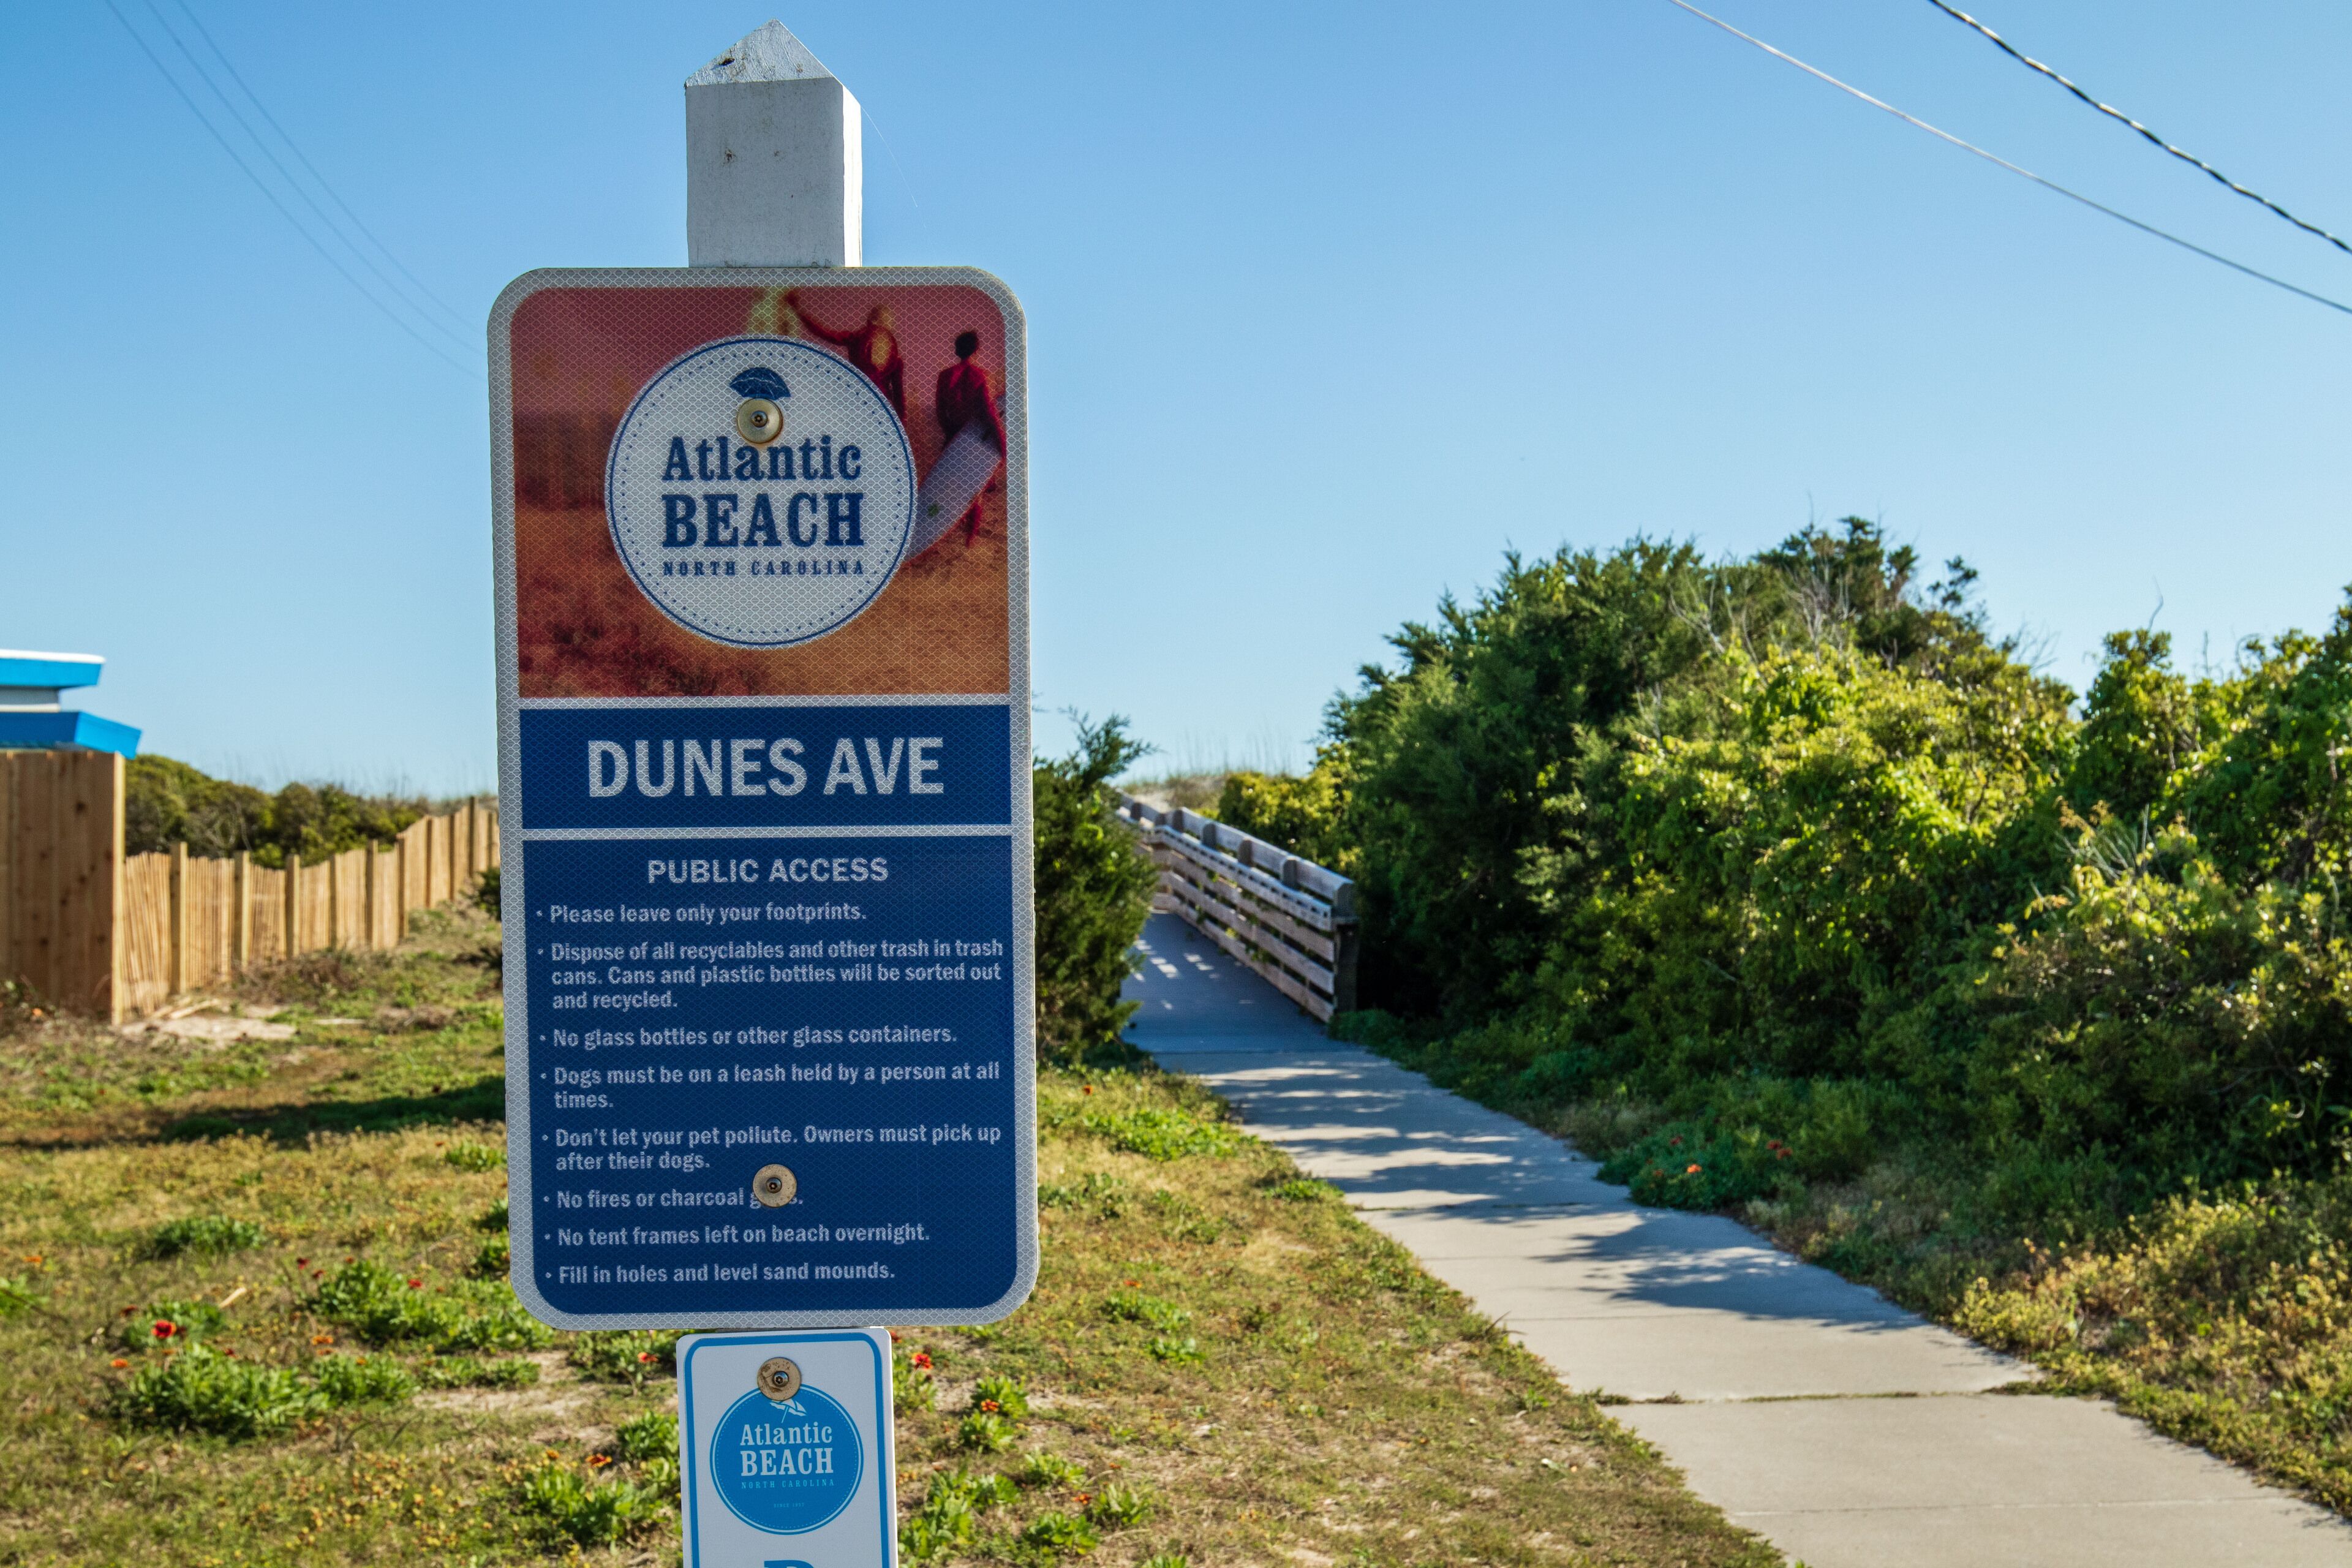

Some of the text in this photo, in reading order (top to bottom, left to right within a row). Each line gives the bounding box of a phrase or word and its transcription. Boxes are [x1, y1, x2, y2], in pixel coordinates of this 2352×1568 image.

[662, 434, 862, 481] Atlantic
[662, 492, 864, 548] BEACH
[663, 559, 864, 576] NORTH CAROLINA
[587, 736, 944, 798] DUNES AVE
[648, 858, 889, 883] PUBLIC ACCESS
[551, 902, 867, 925] Please leave only your footprints.
[551, 938, 1003, 964] Dispose of all recyclables and other trash in trash
[551, 962, 1001, 987] cans. Cans and plastic bottles will be sorted out
[552, 990, 677, 1012] and recycled.
[553, 1025, 957, 1050] No glass bottles or other glass containers.
[554, 1061, 1000, 1088] Dogs must be on a leash held by a person at all
[554, 1091, 614, 1109] times.
[556, 1123, 1001, 1149] Don't let your pet pollute. Owners must pick up
[556, 1151, 710, 1172] after their dogs.
[557, 1190, 582, 1208] No
[587, 1189, 631, 1207] fires
[636, 1193, 655, 1207] or
[660, 1187, 744, 1207] charcoal
[558, 1223, 930, 1246] No tent frames left on beach overnight.
[559, 1261, 895, 1284] Fill in holes and level sand mounds.
[739, 1422, 833, 1446] Atlantic
[741, 1447, 834, 1477] BEACH
[741, 1479, 835, 1490] NORTH CAROLINA
